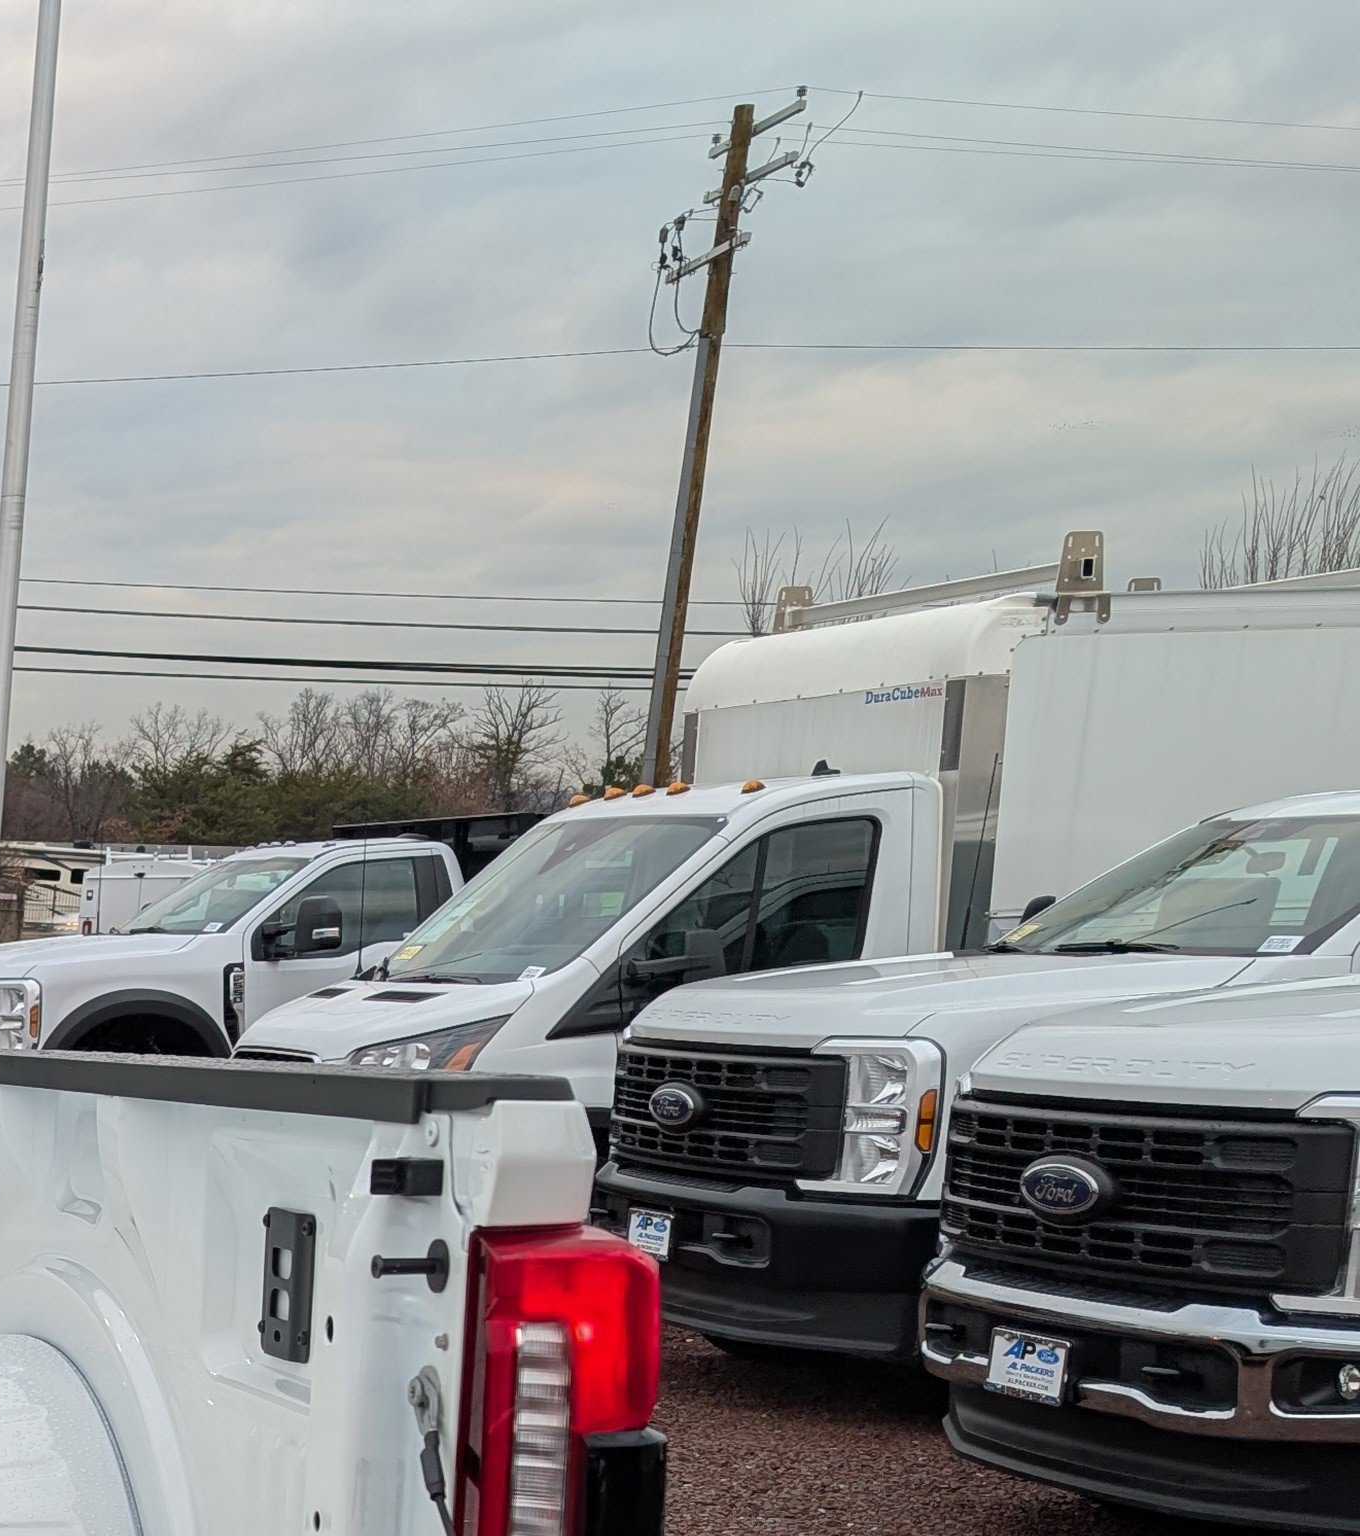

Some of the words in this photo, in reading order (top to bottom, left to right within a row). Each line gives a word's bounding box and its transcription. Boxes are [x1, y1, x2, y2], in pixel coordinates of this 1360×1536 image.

[864, 686, 943, 705] DuraCubeMax
[1034, 1172, 1079, 1204] Ford
[1002, 1337, 1037, 1360] AP
